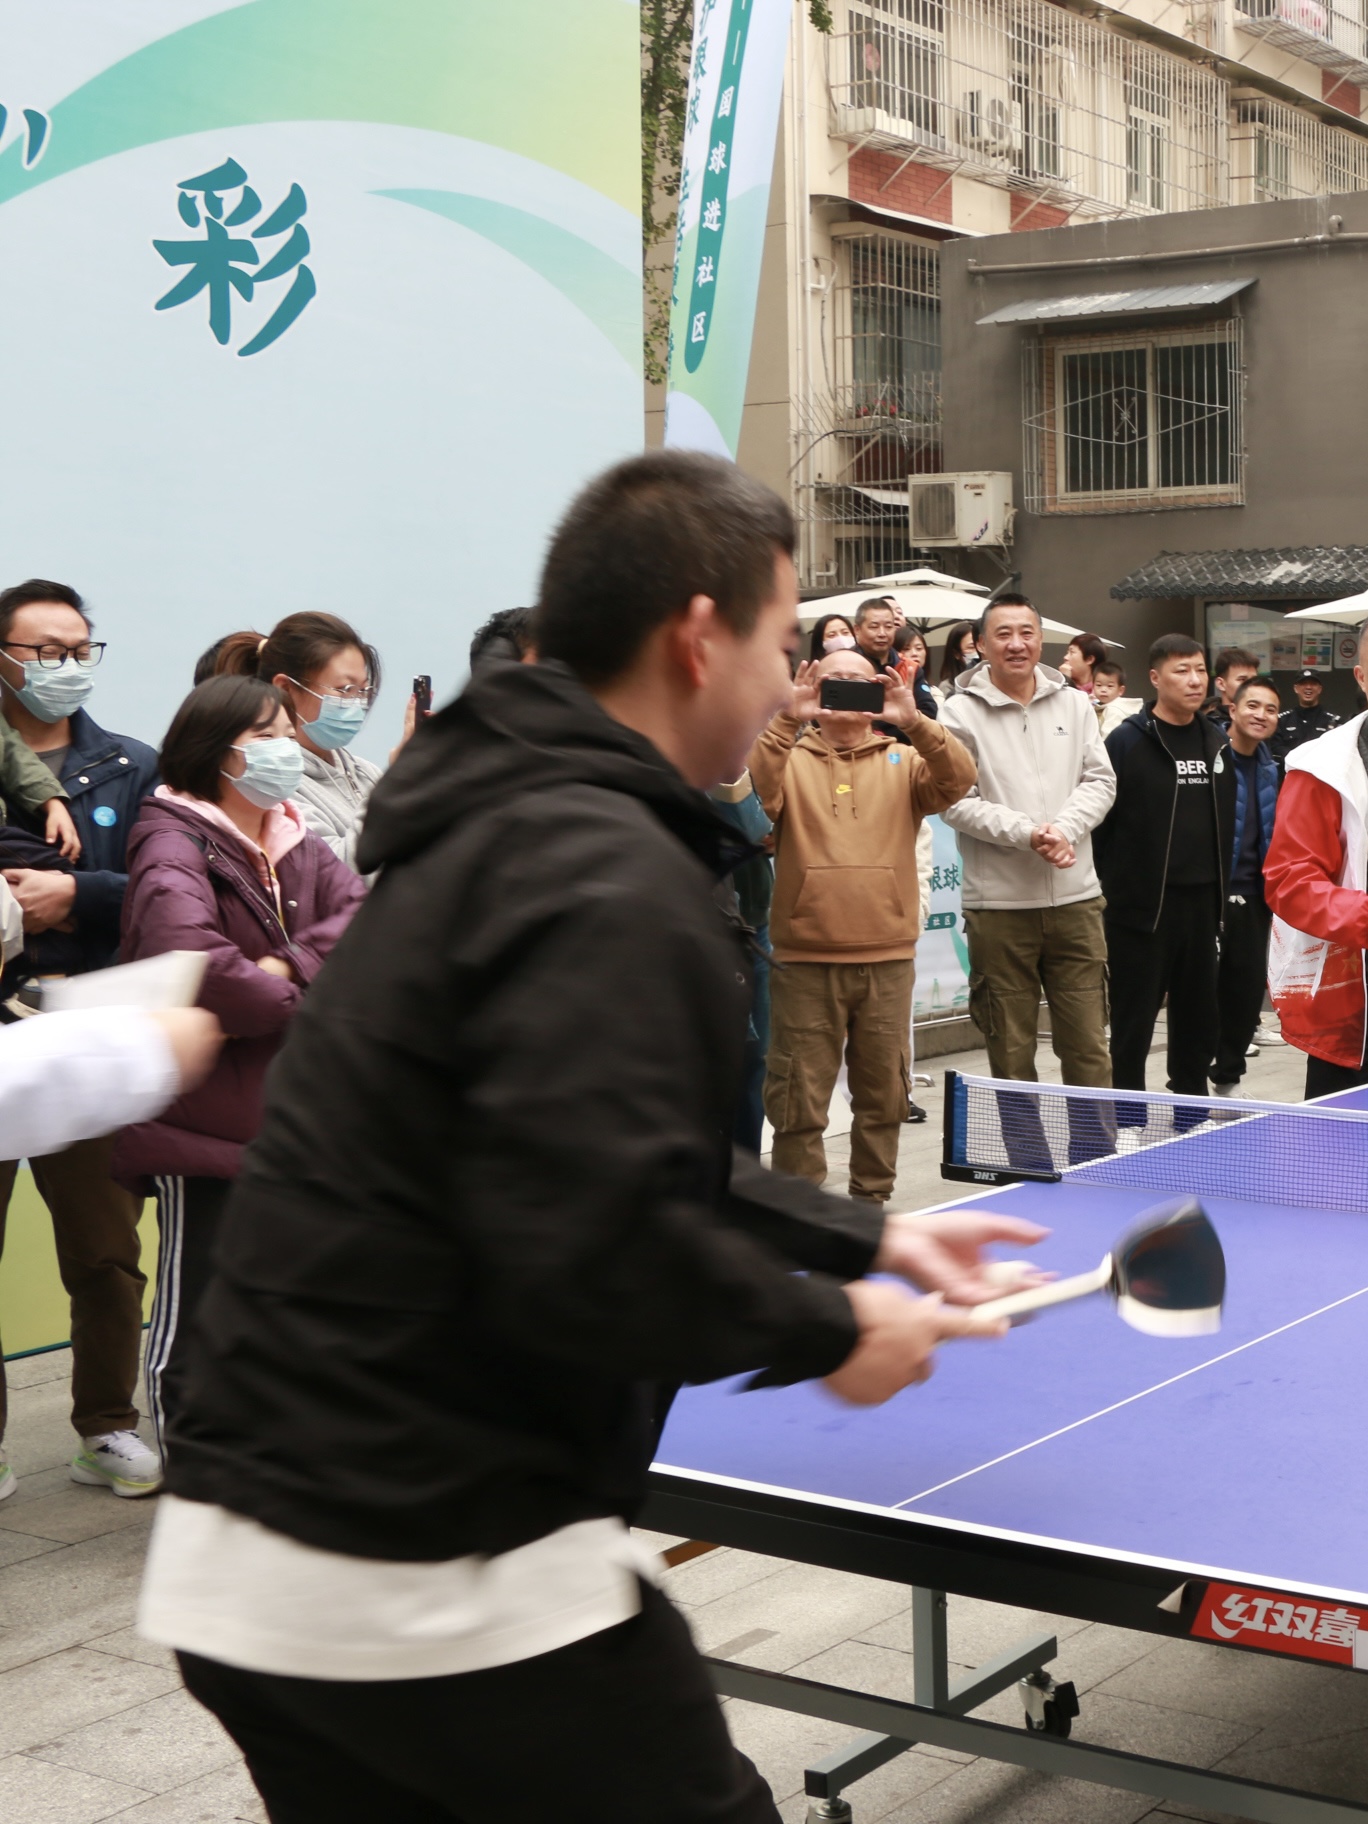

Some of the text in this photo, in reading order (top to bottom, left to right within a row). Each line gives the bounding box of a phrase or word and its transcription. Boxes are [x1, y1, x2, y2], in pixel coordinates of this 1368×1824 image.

[152, 157, 317, 357] 彩
[1211, 1593, 1361, 1648] 红双喜
